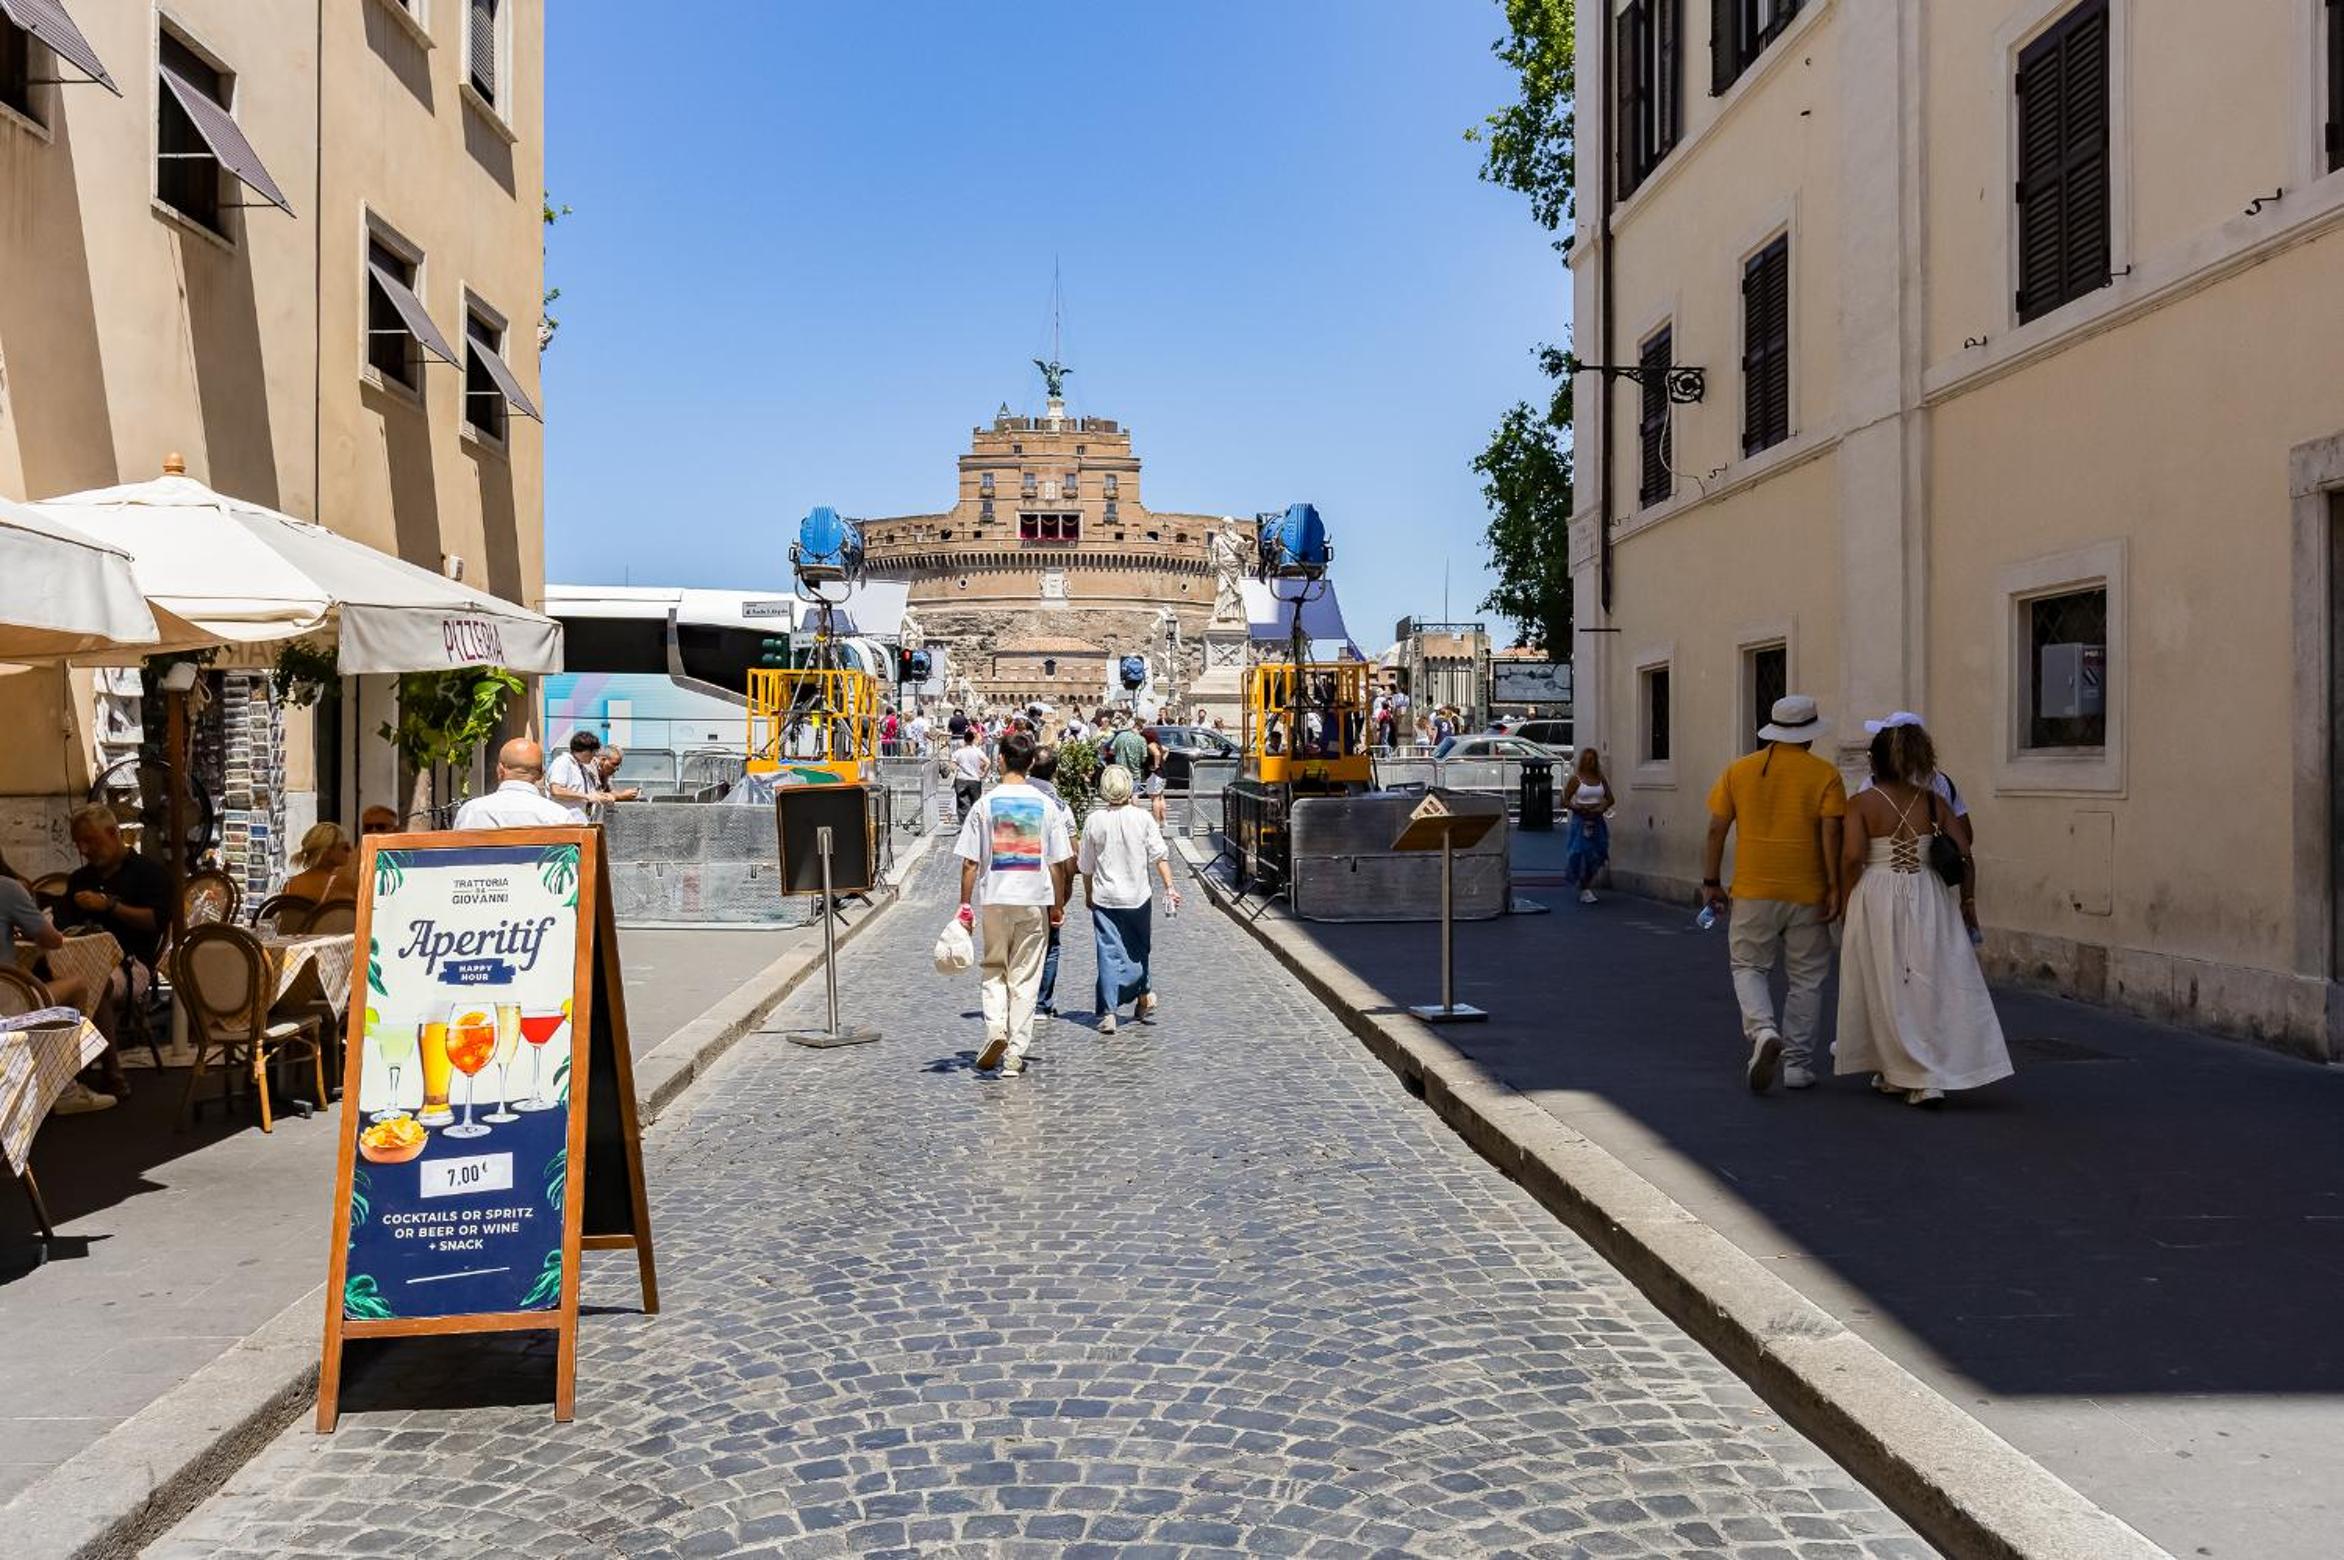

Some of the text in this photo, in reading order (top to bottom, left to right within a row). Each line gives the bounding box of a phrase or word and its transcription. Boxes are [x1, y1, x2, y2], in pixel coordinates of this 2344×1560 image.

[443, 620, 505, 662] PIZZERIA
[453, 878, 509, 888] TRATTORIA
[452, 894, 509, 904] GIOVANNI
[398, 917, 556, 975] Aperitif
[458, 965, 493, 973] HAPPY
[460, 973, 489, 981] HOUR
[382, 1207, 534, 1225] COCKTAILS OR SPRITZ
[394, 1222, 520, 1239] OR BEER OR WINE
[439, 1239, 484, 1251] SNACK
